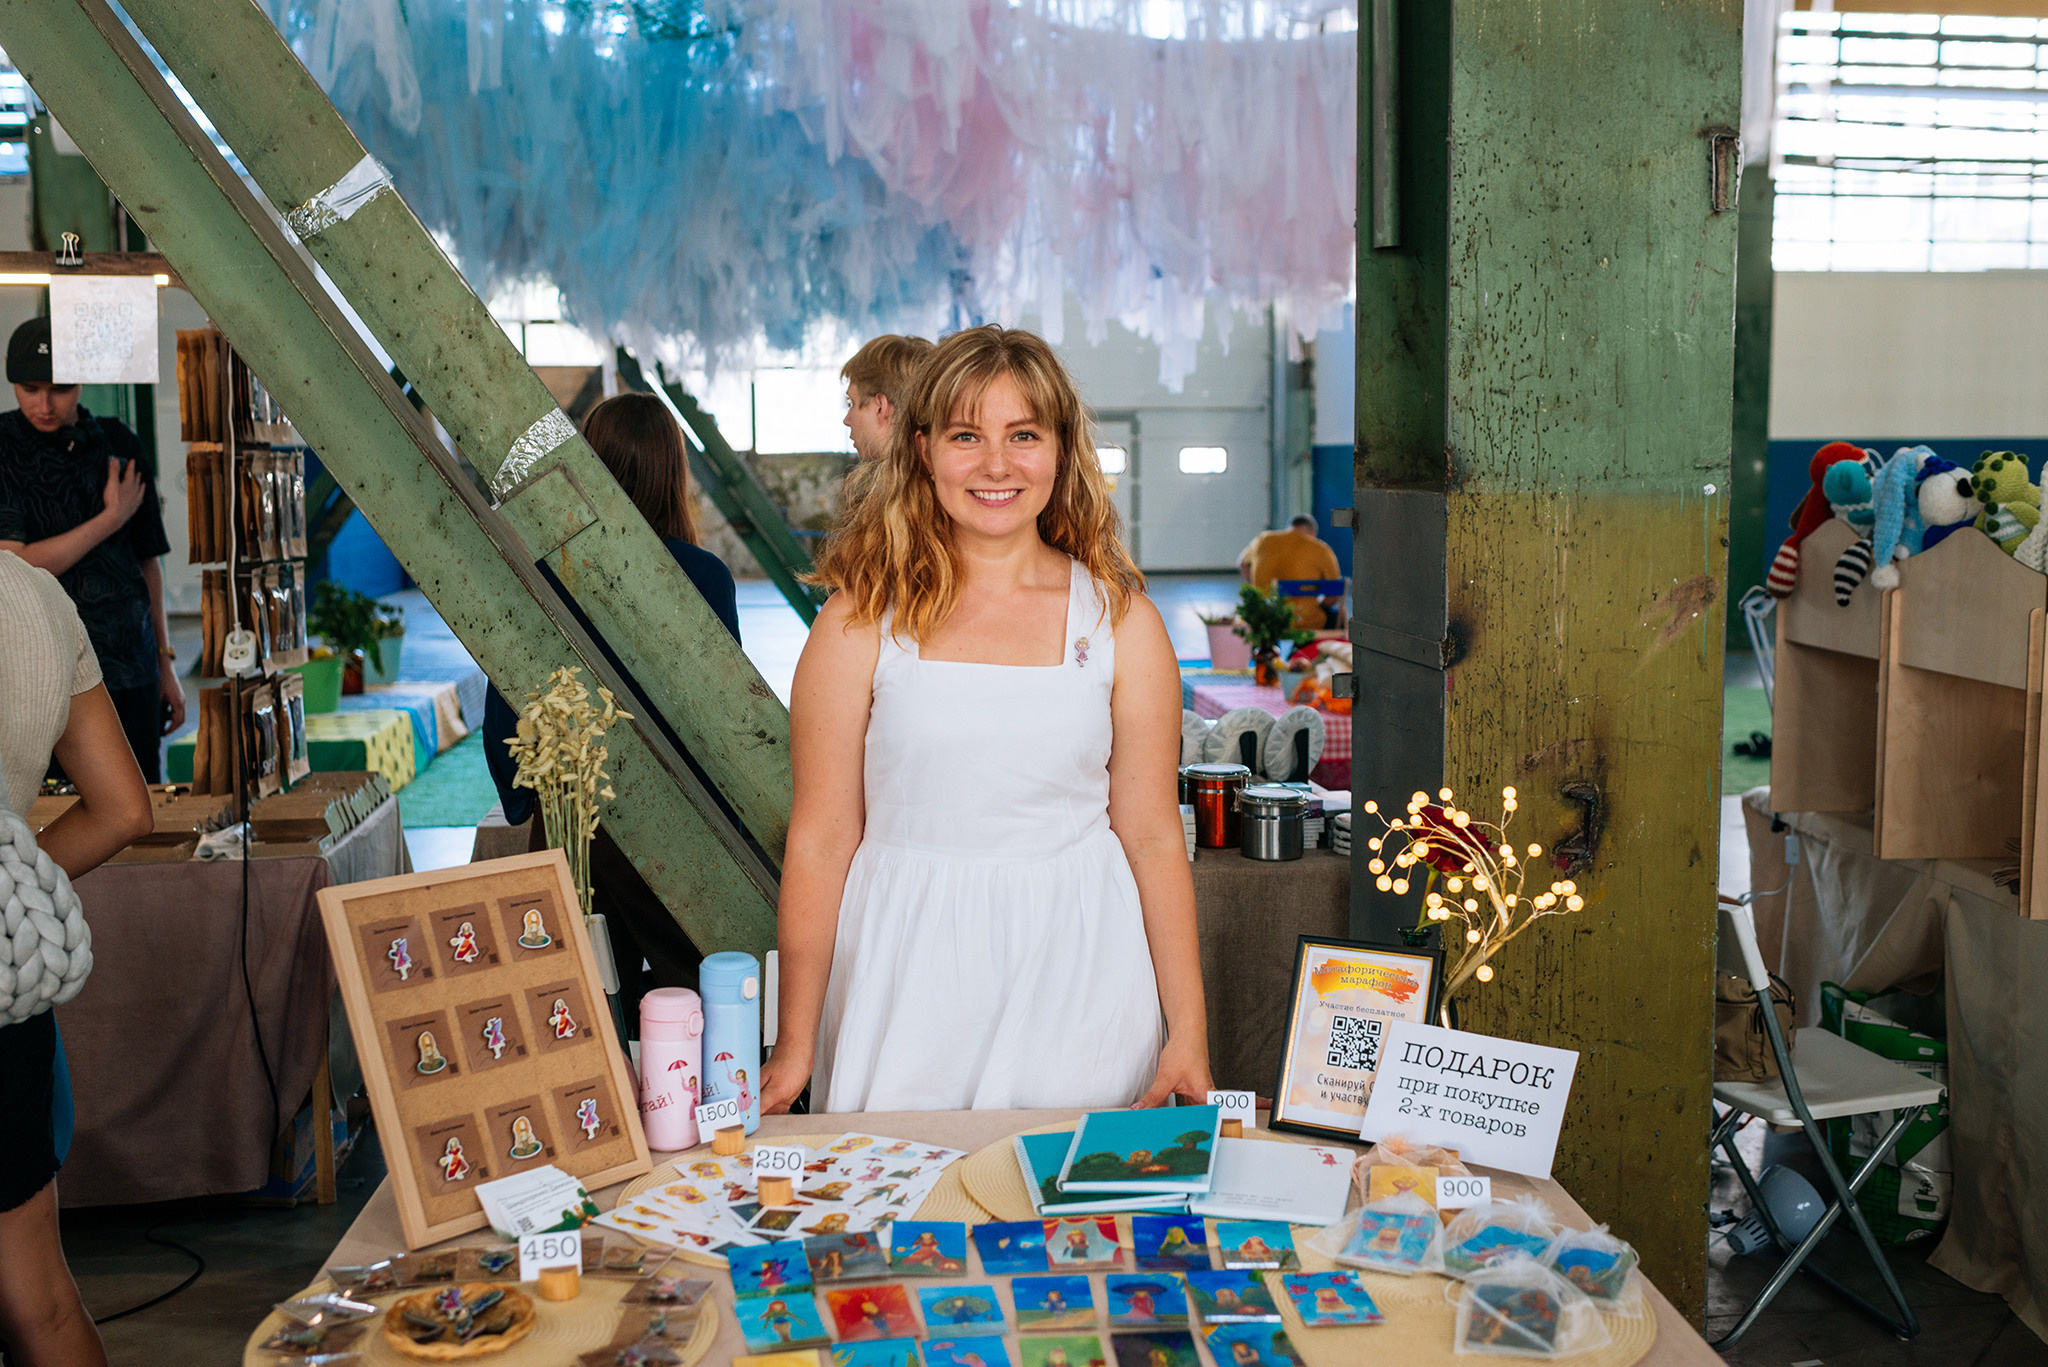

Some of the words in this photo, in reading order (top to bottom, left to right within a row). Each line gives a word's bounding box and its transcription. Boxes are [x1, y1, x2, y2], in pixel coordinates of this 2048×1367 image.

[1314, 965, 1419, 988] Метафорический
[1340, 976, 1393, 990] марафон
[1319, 1000, 1354, 1012] Участие
[1356, 1004, 1406, 1019] бесплатное
[1400, 1041, 1555, 1090] ПОДАРОК
[1317, 1073, 1366, 1092] Сканируй
[1213, 1094, 1249, 1109] 900
[1320, 1090, 1327, 1098] и
[1330, 1091, 1370, 1108] участву
[1397, 1076, 1440, 1096] при
[1443, 1085, 1540, 1116] покупке
[698, 1101, 738, 1123] 1500
[1398, 1097, 1434, 1119] 2-х
[1439, 1108, 1527, 1138] товаров
[756, 1149, 802, 1171] 250
[1443, 1180, 1483, 1197] 900
[523, 1235, 577, 1261] 450
